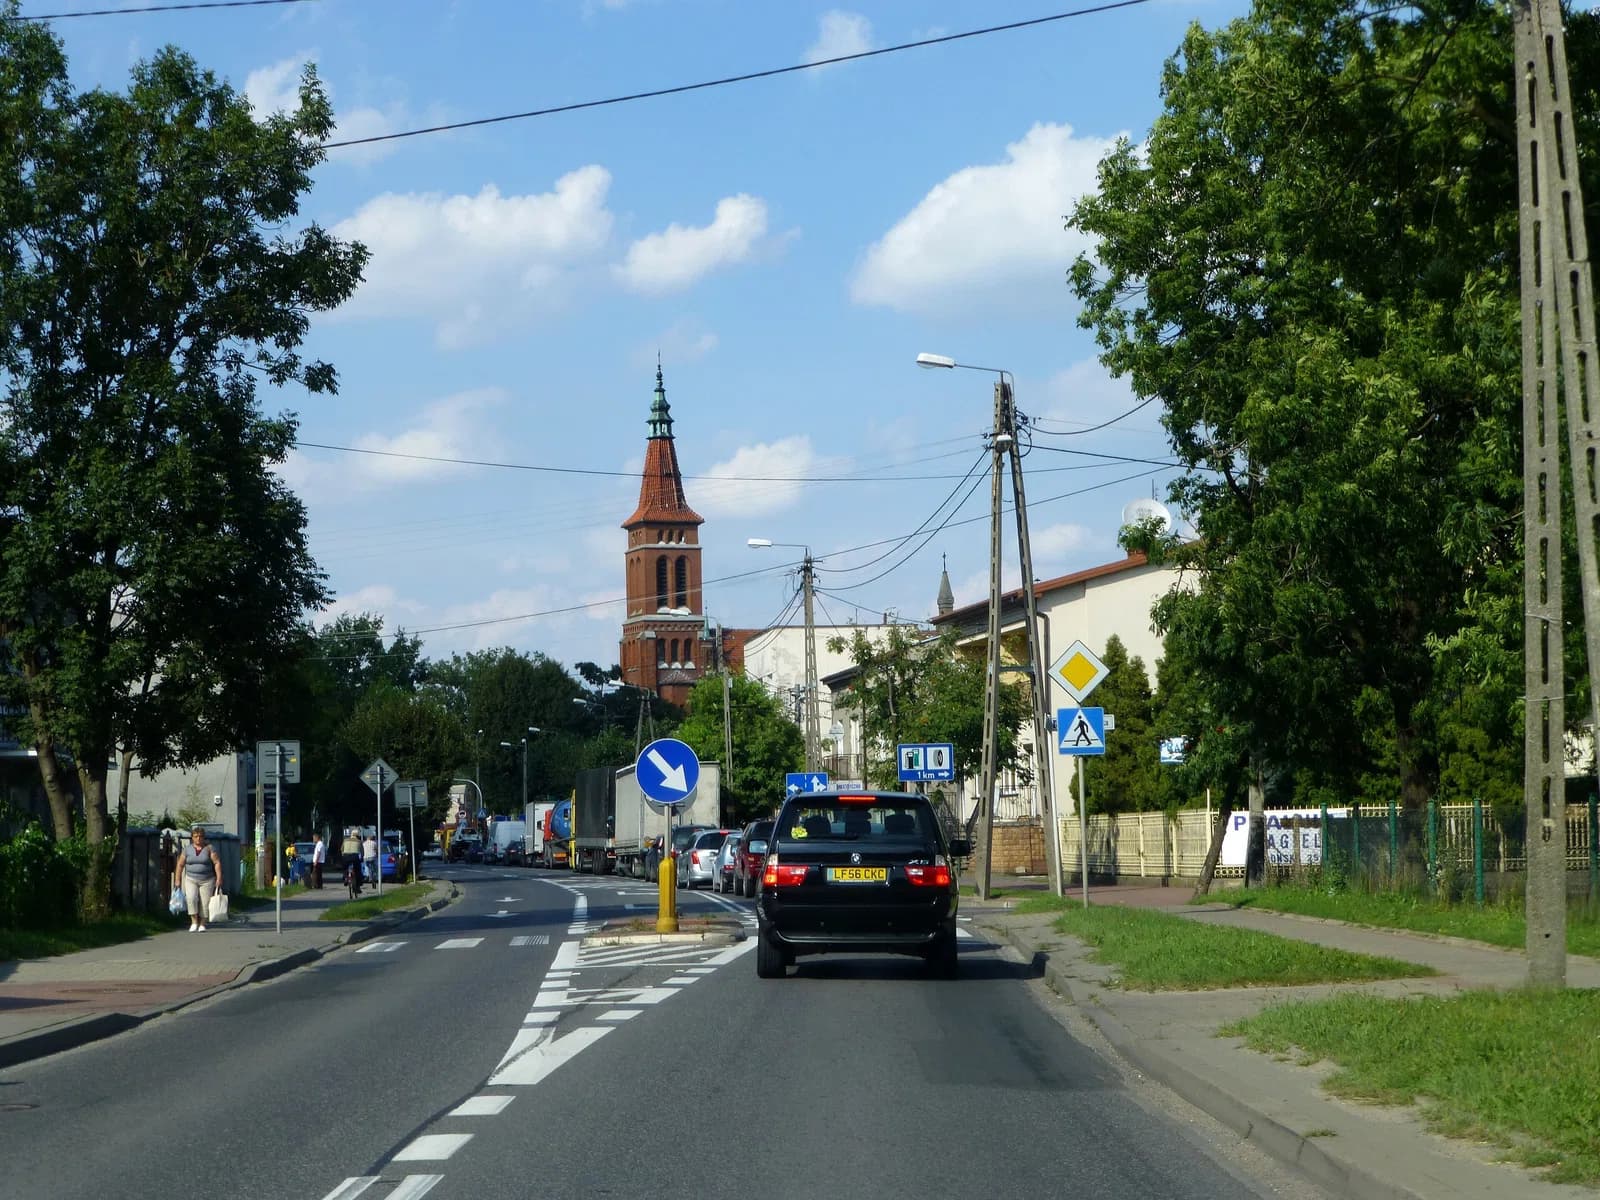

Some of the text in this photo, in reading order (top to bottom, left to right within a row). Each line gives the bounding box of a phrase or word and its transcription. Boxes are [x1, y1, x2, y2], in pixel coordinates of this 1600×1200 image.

[923, 771, 935, 779] km
[834, 869, 884, 879] LF56 CKC
